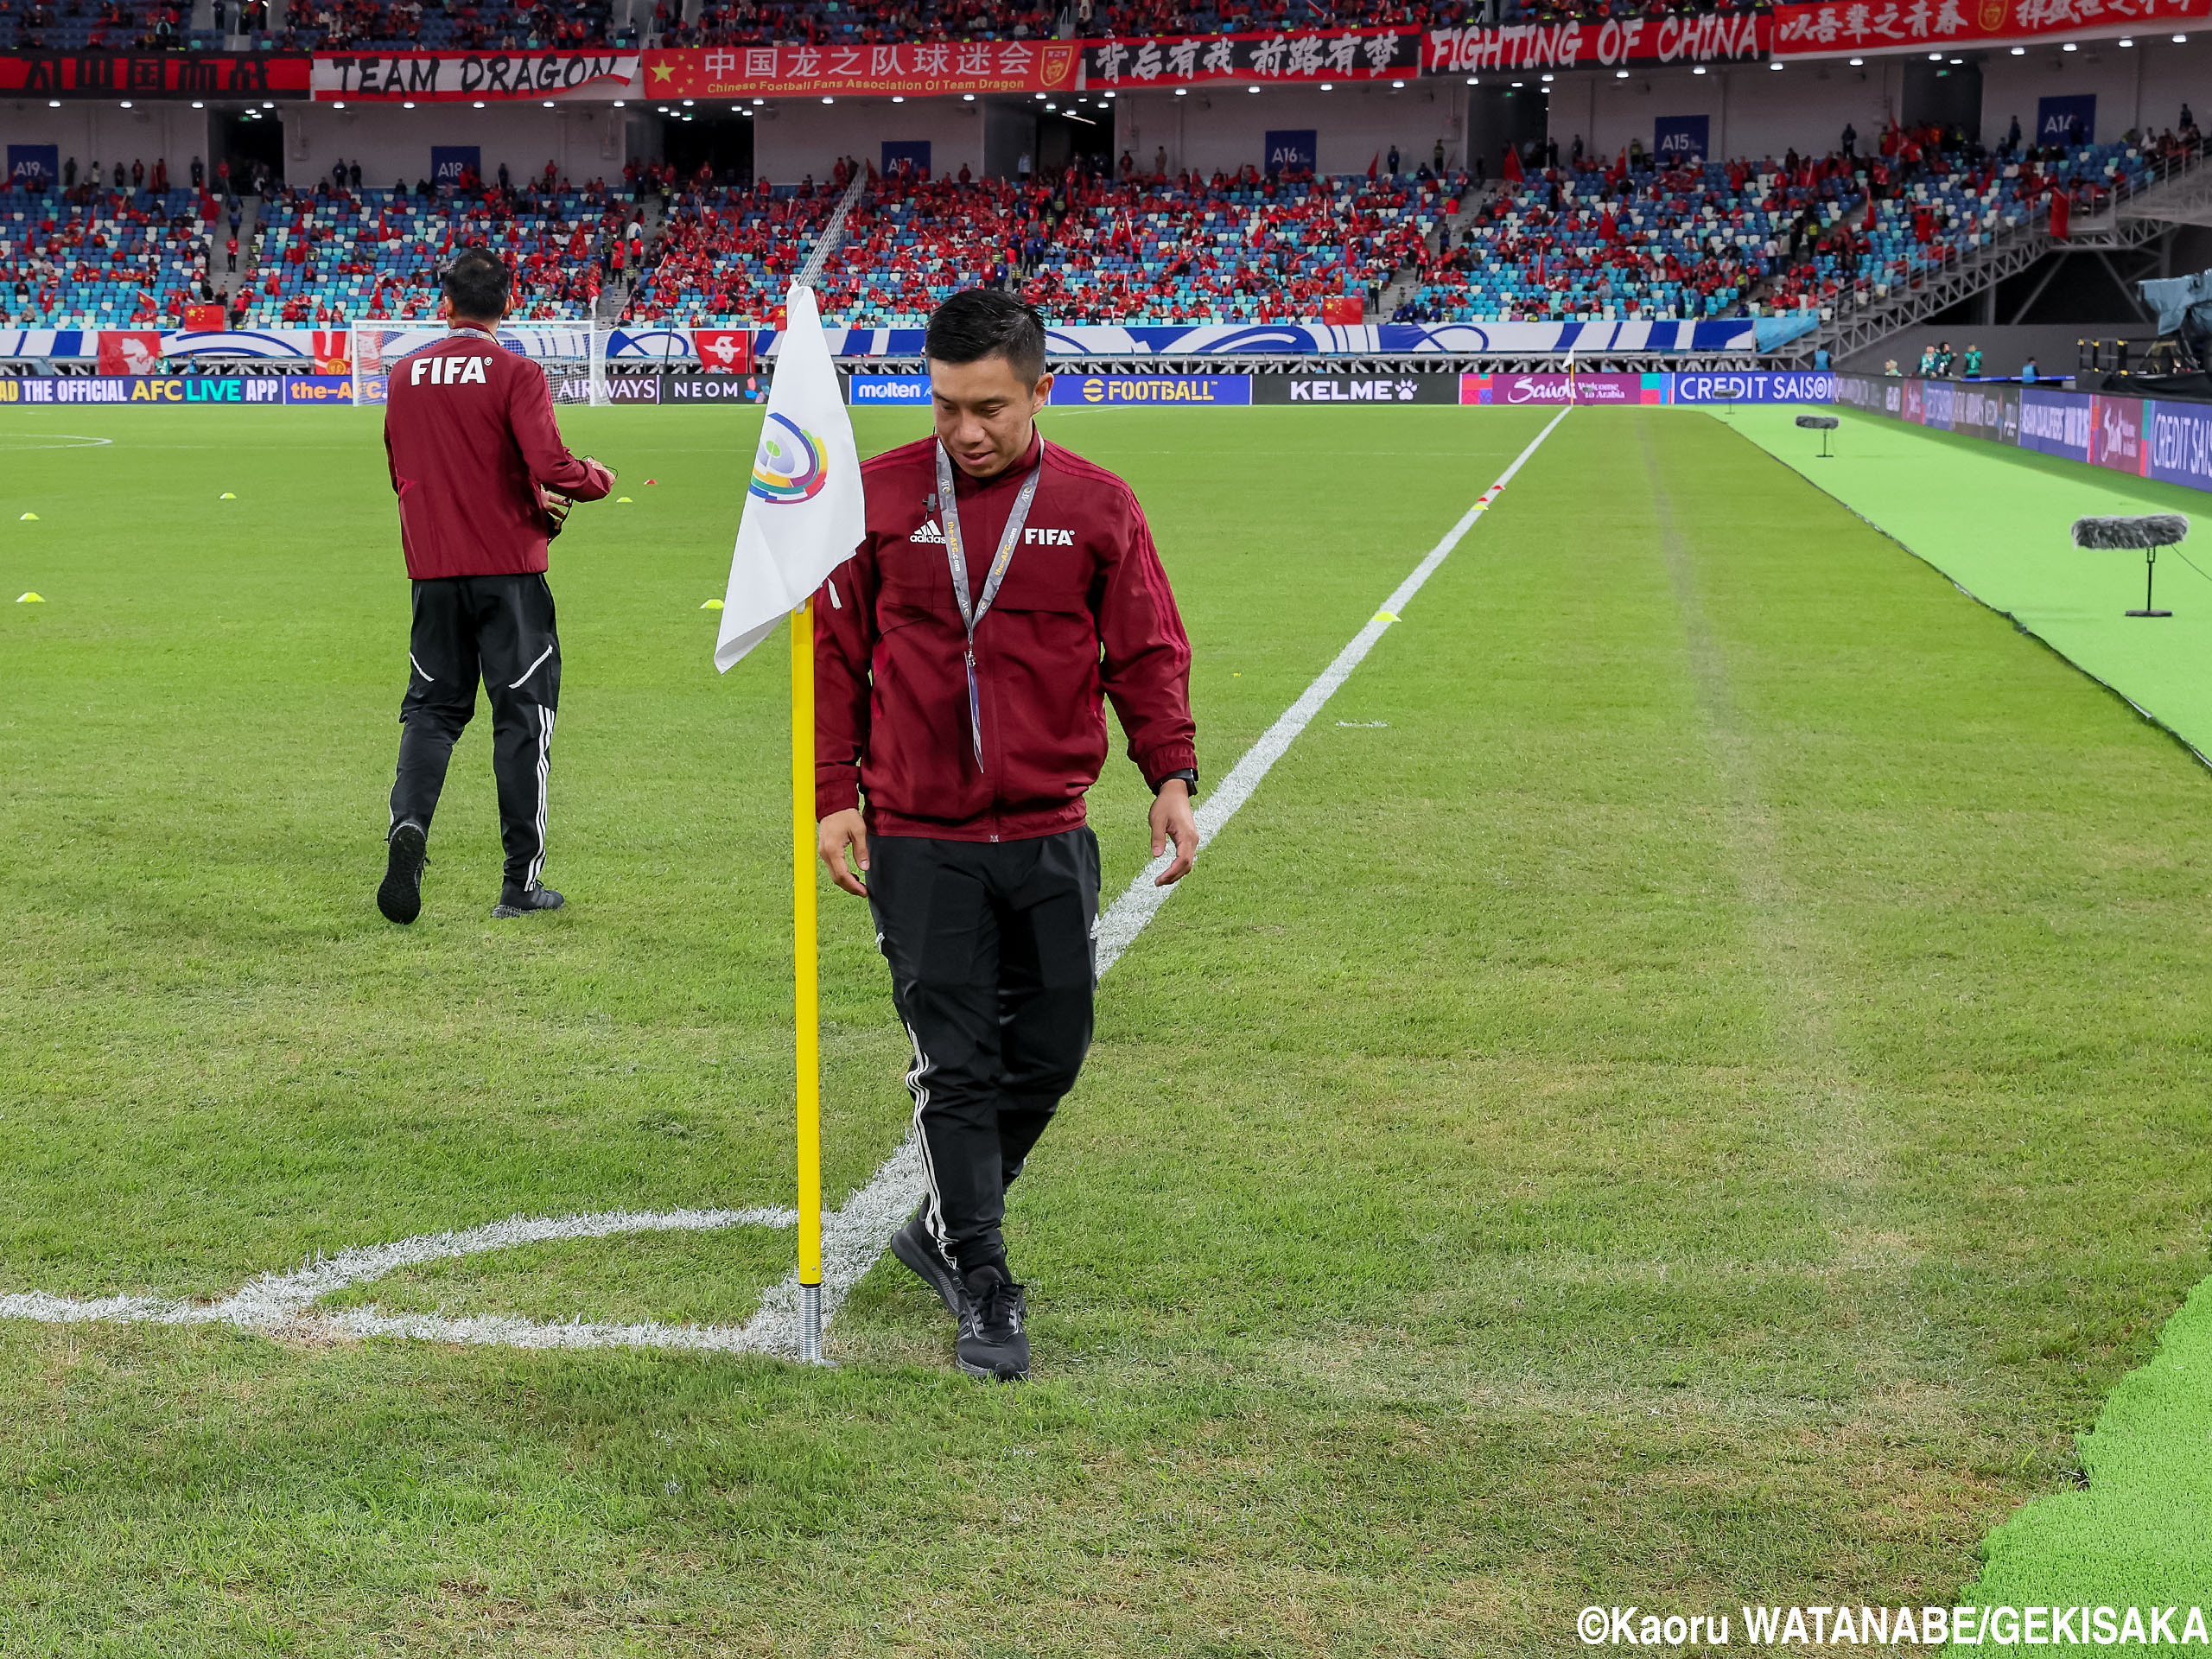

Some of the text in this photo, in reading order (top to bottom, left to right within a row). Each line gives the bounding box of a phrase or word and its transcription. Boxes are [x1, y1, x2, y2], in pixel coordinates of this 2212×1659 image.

[1431, 10, 1759, 74] FIGHTING OF CHINA
[704, 41, 1034, 80] 中国龙之队球迷会
[1095, 29, 1400, 84] 背后有我 前路有梦
[332, 54, 441, 97] TEAM
[707, 79, 1025, 93] Chinese Football Fans Association Of Team Dragon
[1661, 134, 1689, 150] A15
[1271, 147, 1299, 163] A16
[15, 161, 41, 176] A19
[22, 379, 54, 402] THE
[57, 379, 127, 402] OFFICIAL
[130, 379, 183, 402] AFC
[186, 379, 242, 402] LIVE
[245, 379, 278, 402] APP
[674, 381, 739, 397] NEOM
[858, 382, 921, 398] molten
[1290, 380, 1394, 401] KELME
[1680, 377, 1768, 400] CREDIT
[2153, 412, 2191, 471] CREDIT
[910, 533, 946, 544] adidas
[947, 521, 961, 572] the-AFC.com
[995, 527, 1018, 576] the-AFC.com
